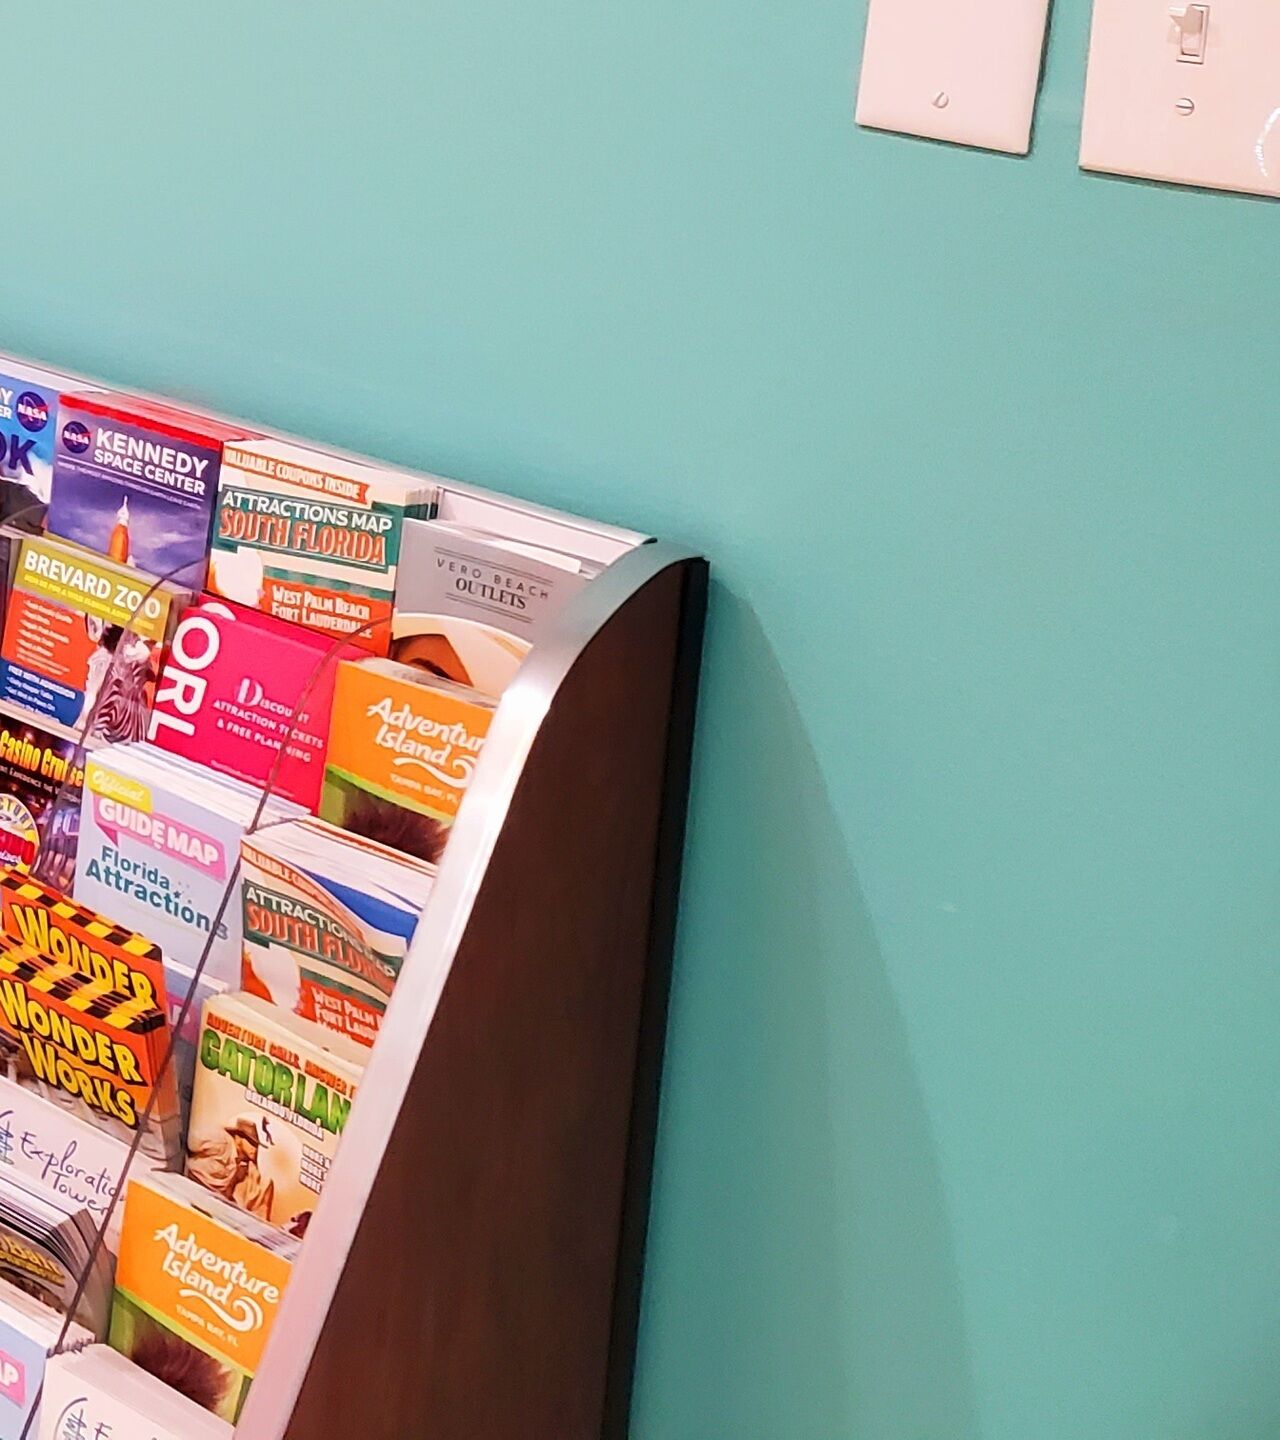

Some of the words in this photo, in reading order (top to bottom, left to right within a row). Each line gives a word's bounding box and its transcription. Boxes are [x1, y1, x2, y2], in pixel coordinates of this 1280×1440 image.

[224, 447, 275, 477] VALUABLE
[276, 462, 324, 491] COUPONS
[324, 474, 362, 500] INSIDE
[221, 489, 349, 527] ATTRACTIONS
[352, 510, 393, 532] MAP
[220, 507, 289, 548] SOUTH
[293, 524, 386, 565] FLORIDA
[24, 550, 111, 599] BREVARD
[114, 585, 161, 619] ZOO
[436, 557, 483, 579] VERO
[494, 573, 550, 599] BEACH
[455, 577, 528, 610] OUTLETS
[271, 603, 301, 624] FORT
[301, 610, 373, 639] LAUDERDALE
[272, 585, 302, 606] WEST
[302, 590, 335, 614] PALM
[335, 599, 371, 620] BEACH
[148, 616, 220, 741] ORL
[213, 699, 277, 732] ATTRACTION
[278, 721, 324, 749] TICKETS
[226, 722, 252, 741] FREE
[375, 726, 451, 766] Island
[99, 797, 166, 842] GUIDE
[167, 825, 220, 867] MAP
[101, 847, 171, 889] Florida
[51, 1171, 111, 1216] Tower
[154, 1223, 280, 1305] Adventure
